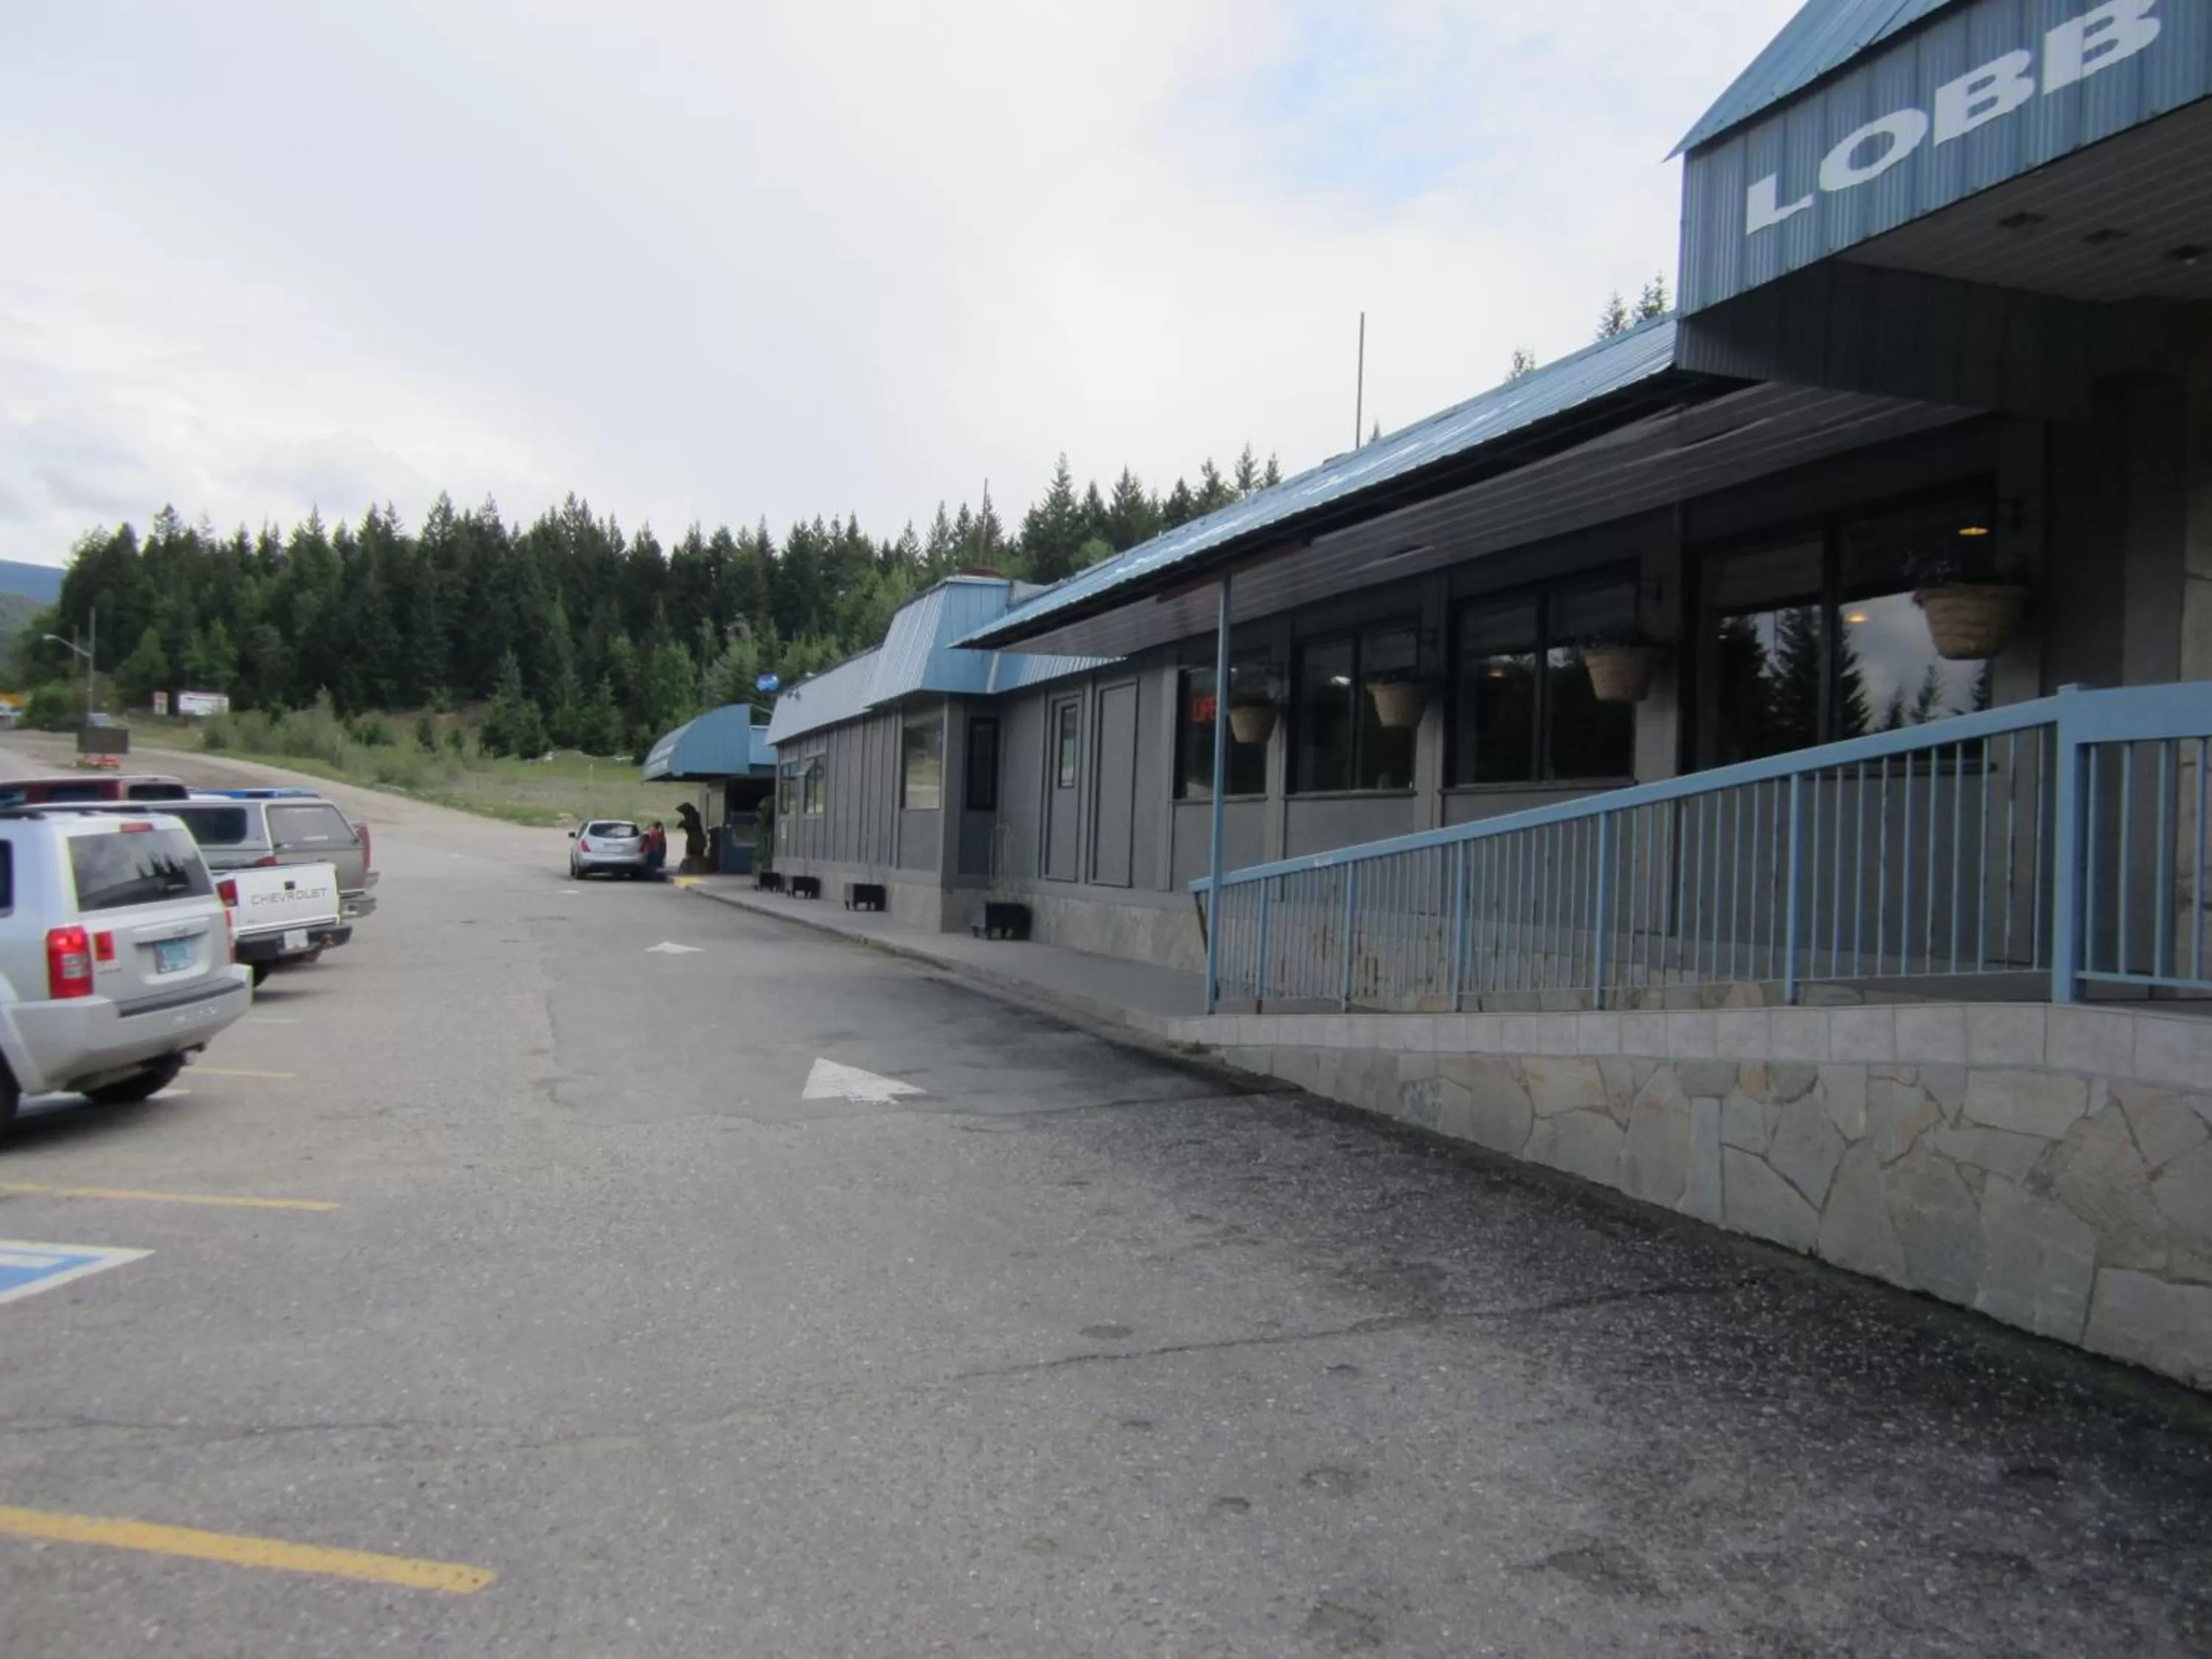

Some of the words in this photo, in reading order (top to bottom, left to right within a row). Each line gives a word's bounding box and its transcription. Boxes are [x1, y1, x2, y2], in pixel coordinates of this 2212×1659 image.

[1746, 0, 2160, 235] LOBB
[1192, 695, 1217, 722] OPE
[250, 886, 328, 906] CHEVROLET
